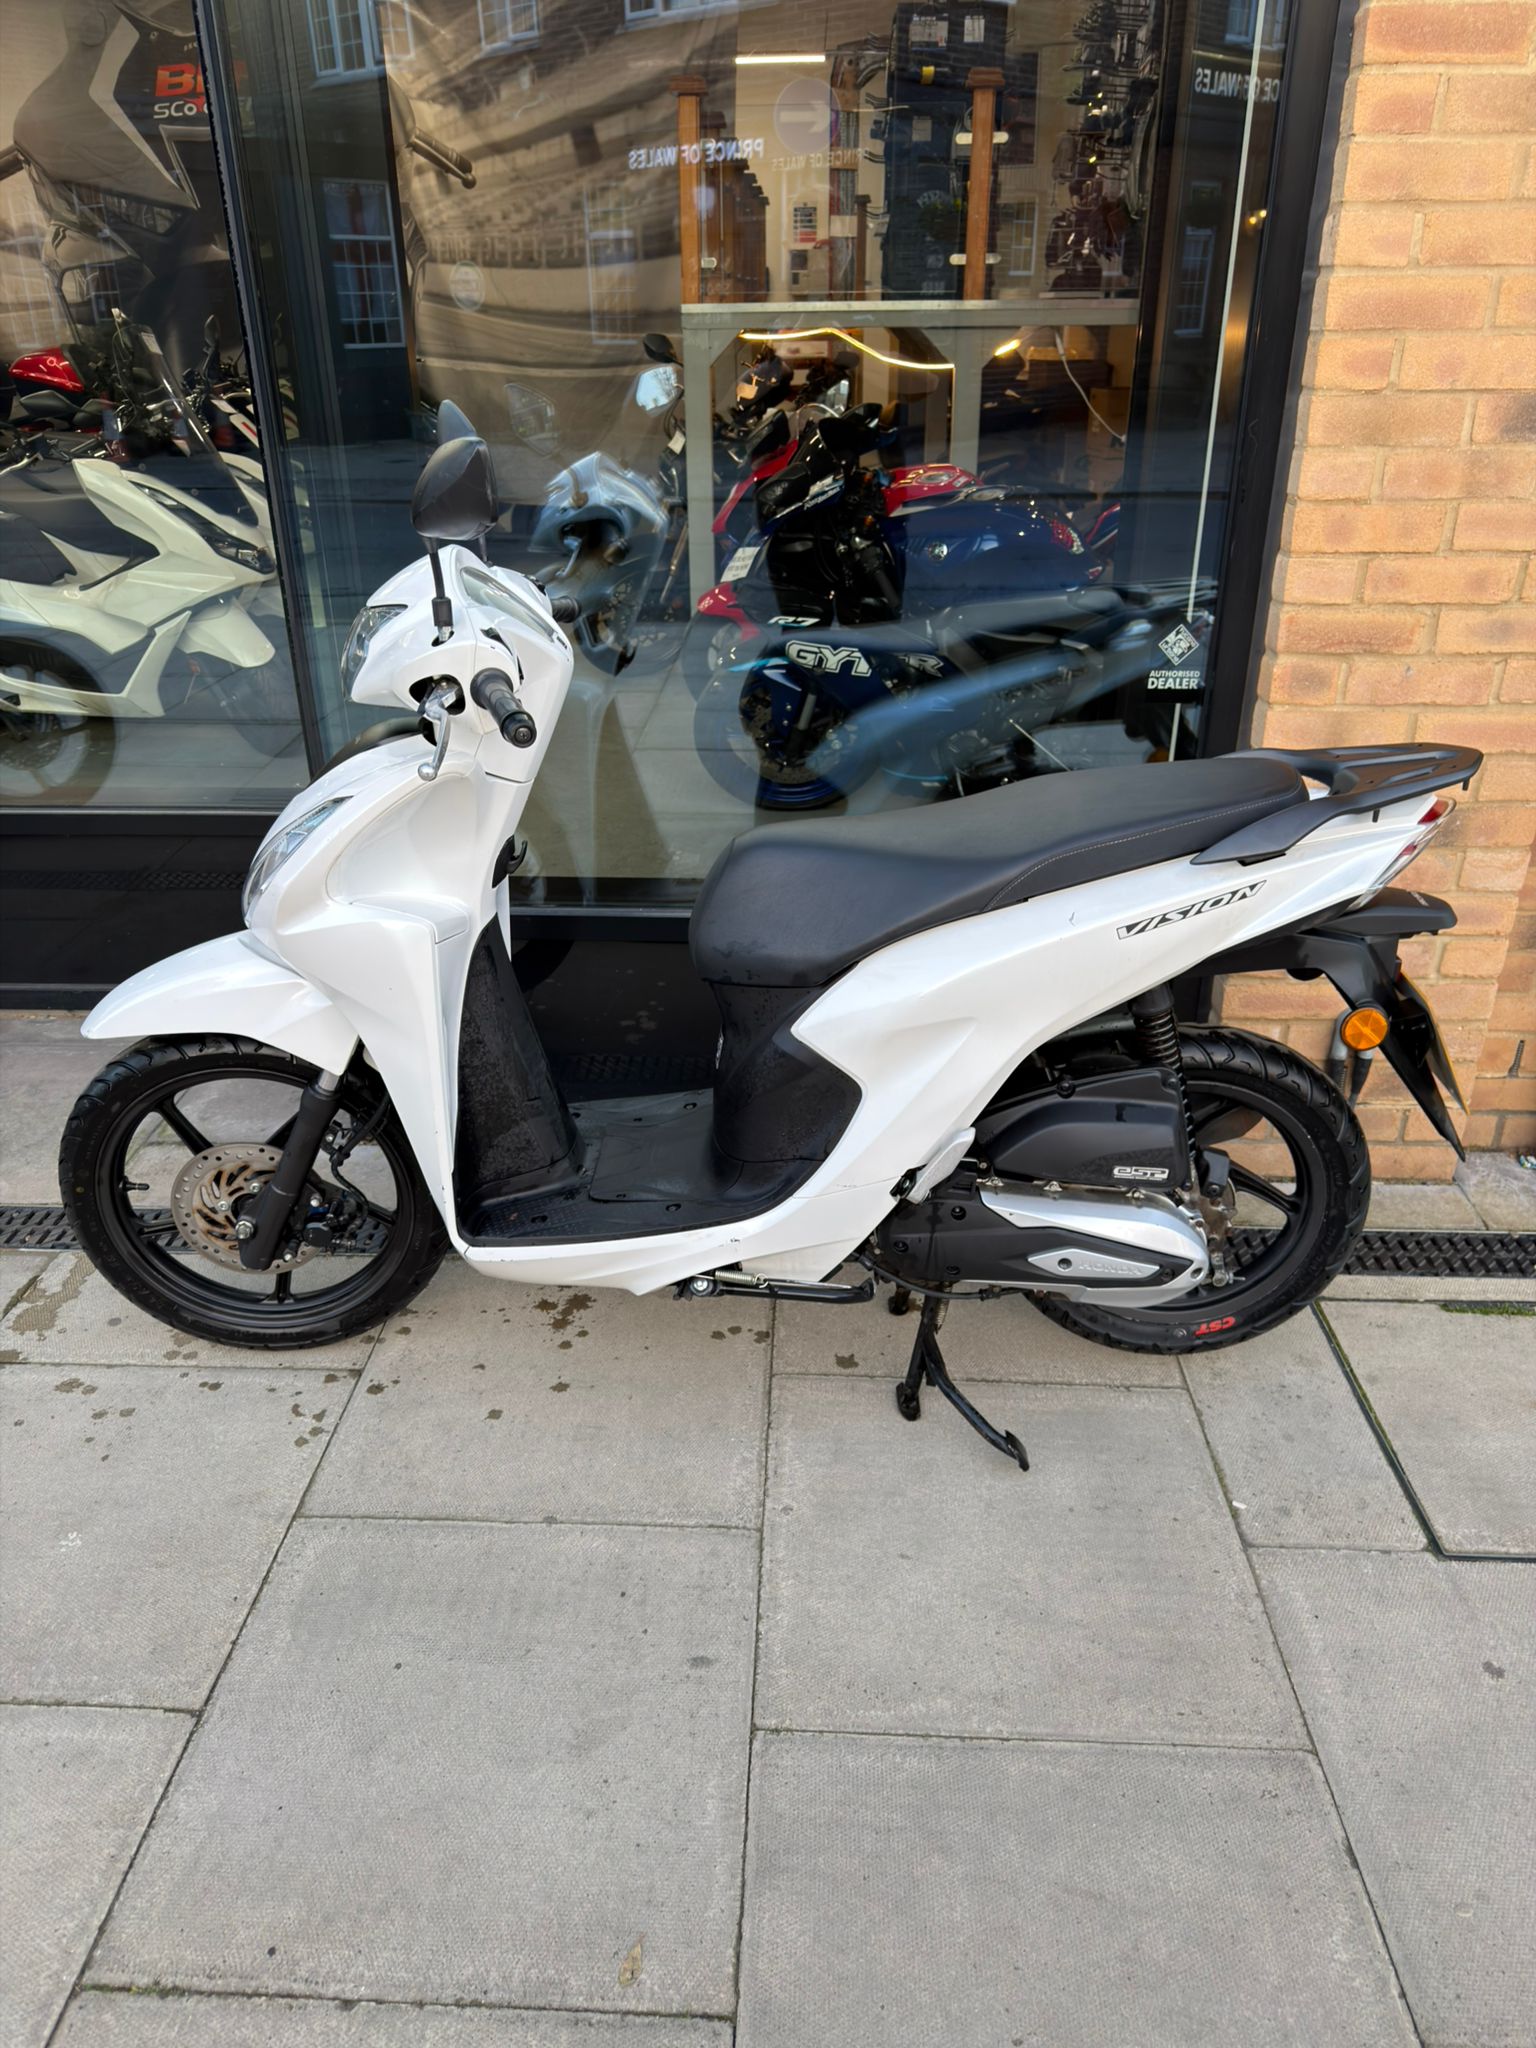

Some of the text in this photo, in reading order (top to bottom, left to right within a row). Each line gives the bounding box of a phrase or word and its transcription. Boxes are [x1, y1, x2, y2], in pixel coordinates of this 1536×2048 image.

[767, 615, 821, 628] R7
[1149, 669, 1200, 678] AUTHORISED
[1147, 677, 1199, 690] DEALER
[1116, 879, 1267, 940] VISION
[1194, 1316, 1236, 1337] CST
